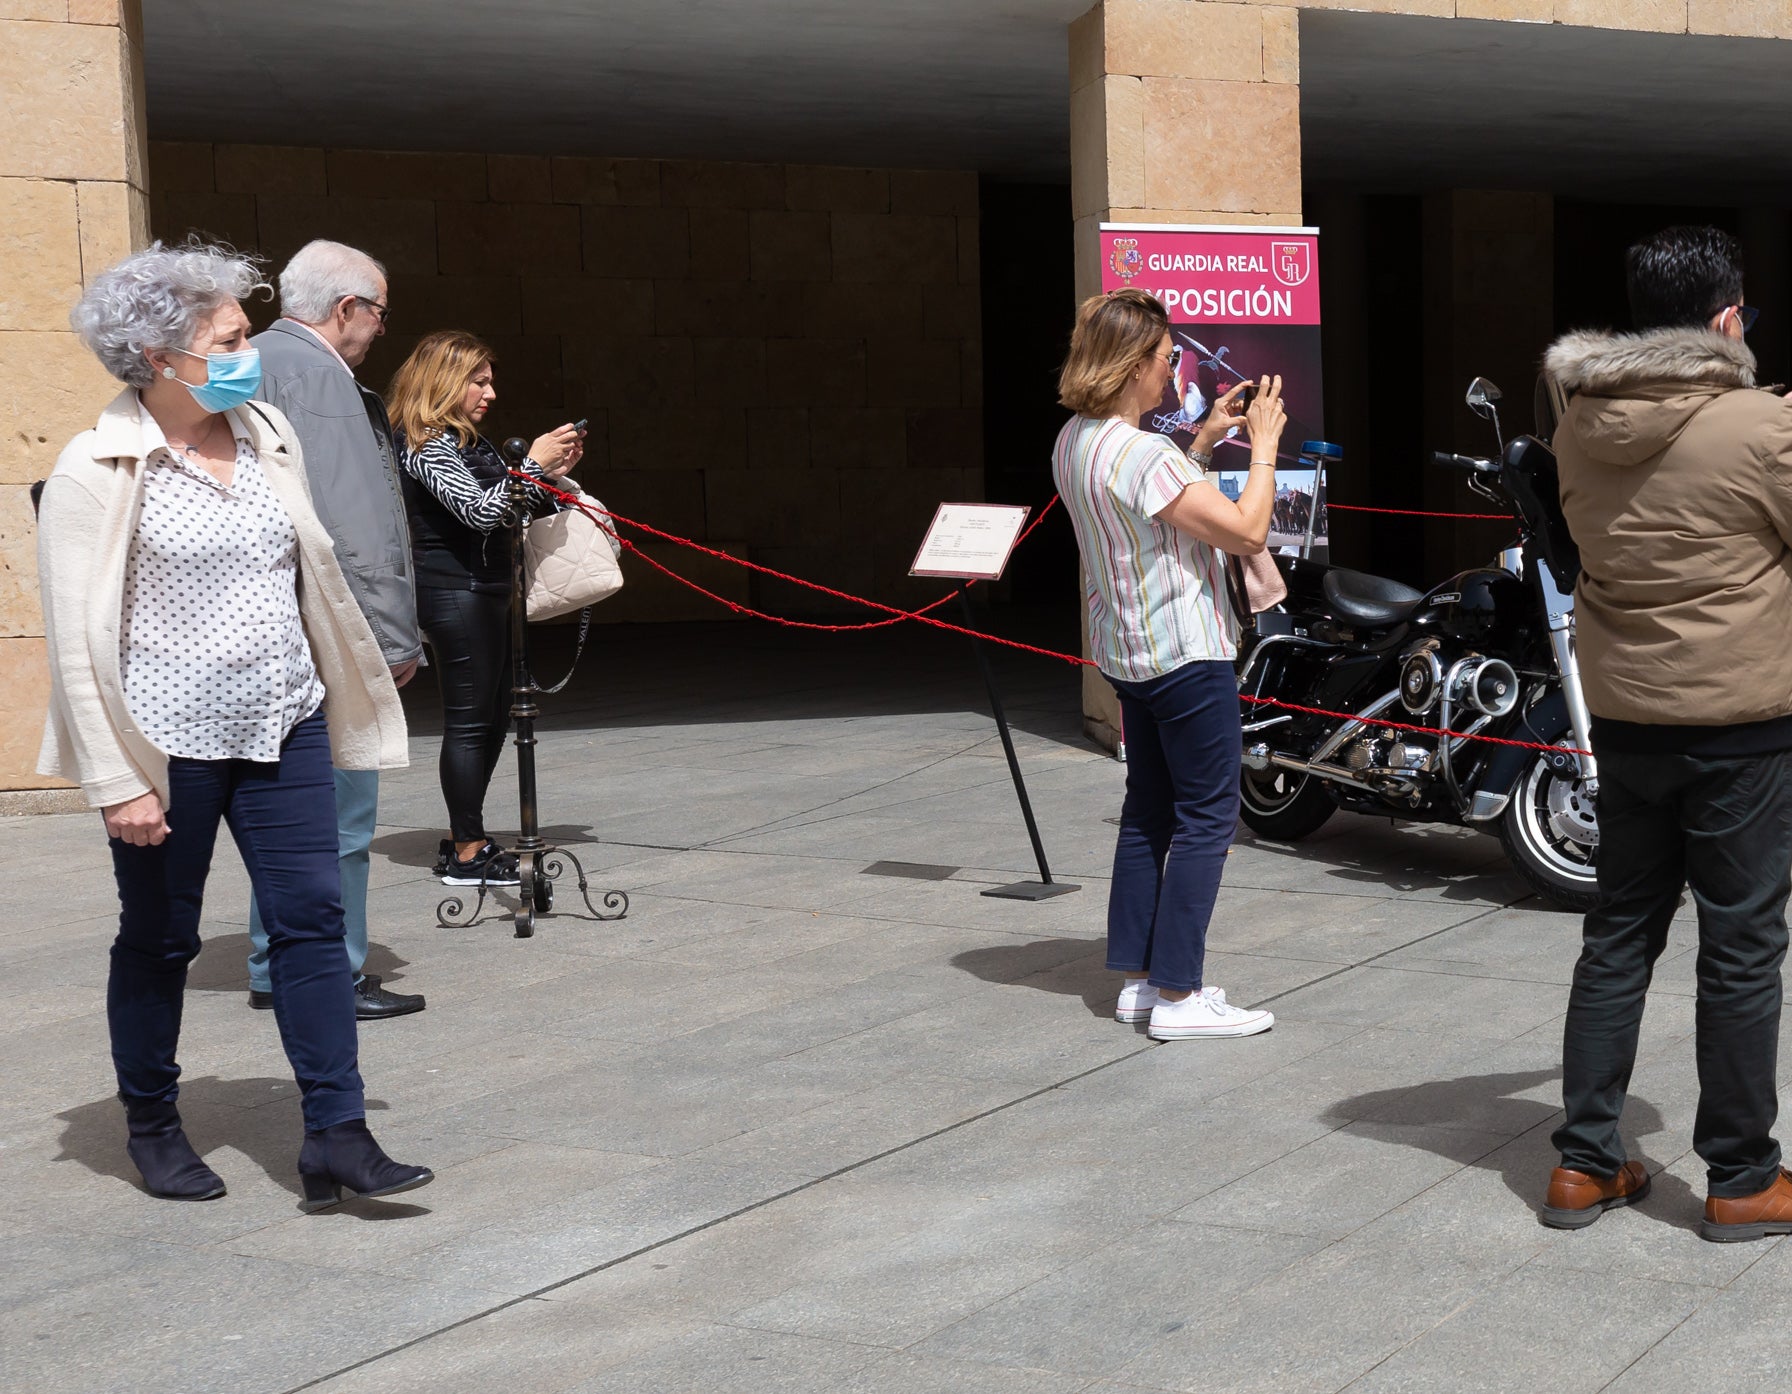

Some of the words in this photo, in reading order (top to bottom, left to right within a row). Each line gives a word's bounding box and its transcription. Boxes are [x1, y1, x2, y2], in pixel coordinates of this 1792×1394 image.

[1148, 253, 1224, 272] GUARDIA
[1227, 255, 1268, 273] REAL
[1142, 284, 1292, 317] POSICIÓN
